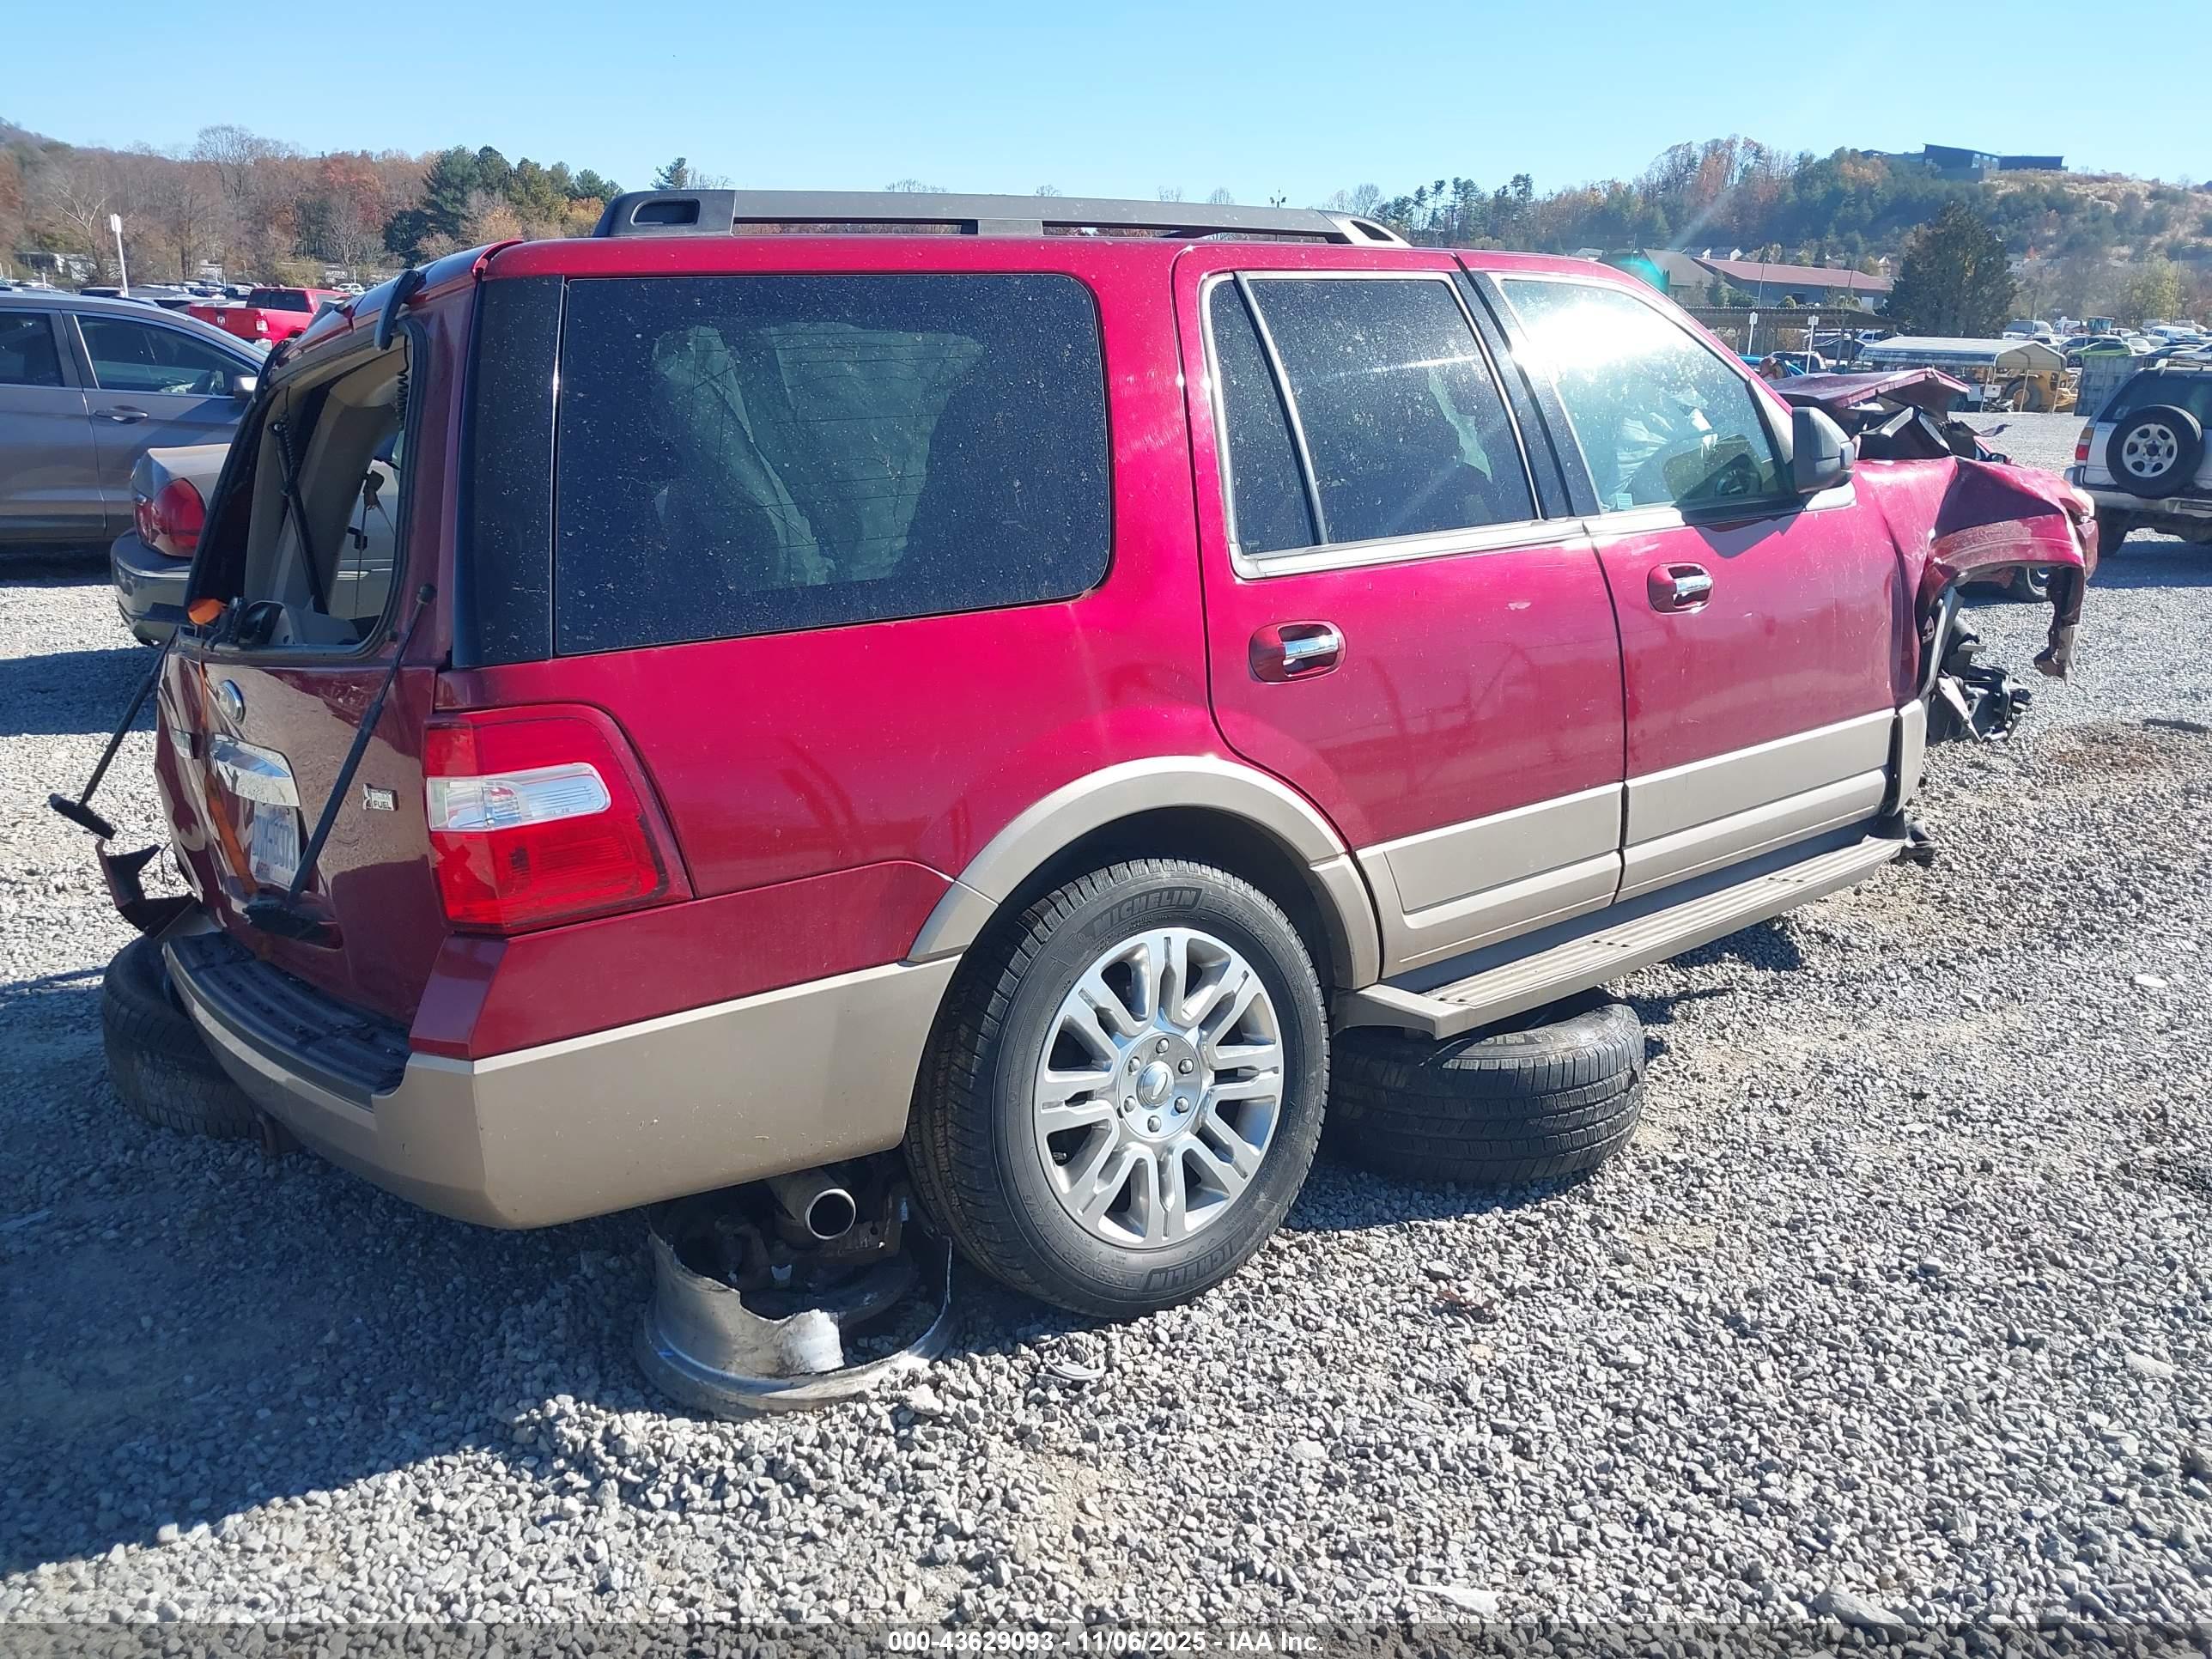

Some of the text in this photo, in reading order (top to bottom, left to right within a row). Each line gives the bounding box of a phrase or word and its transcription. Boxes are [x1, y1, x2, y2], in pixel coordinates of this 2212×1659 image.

[374, 800, 392, 810] FUEL
[1094, 890, 1197, 936] MICHELIN
[1061, 1249, 1137, 1286] DEFENDER
[1149, 1234, 1245, 1289] MICHELIN
